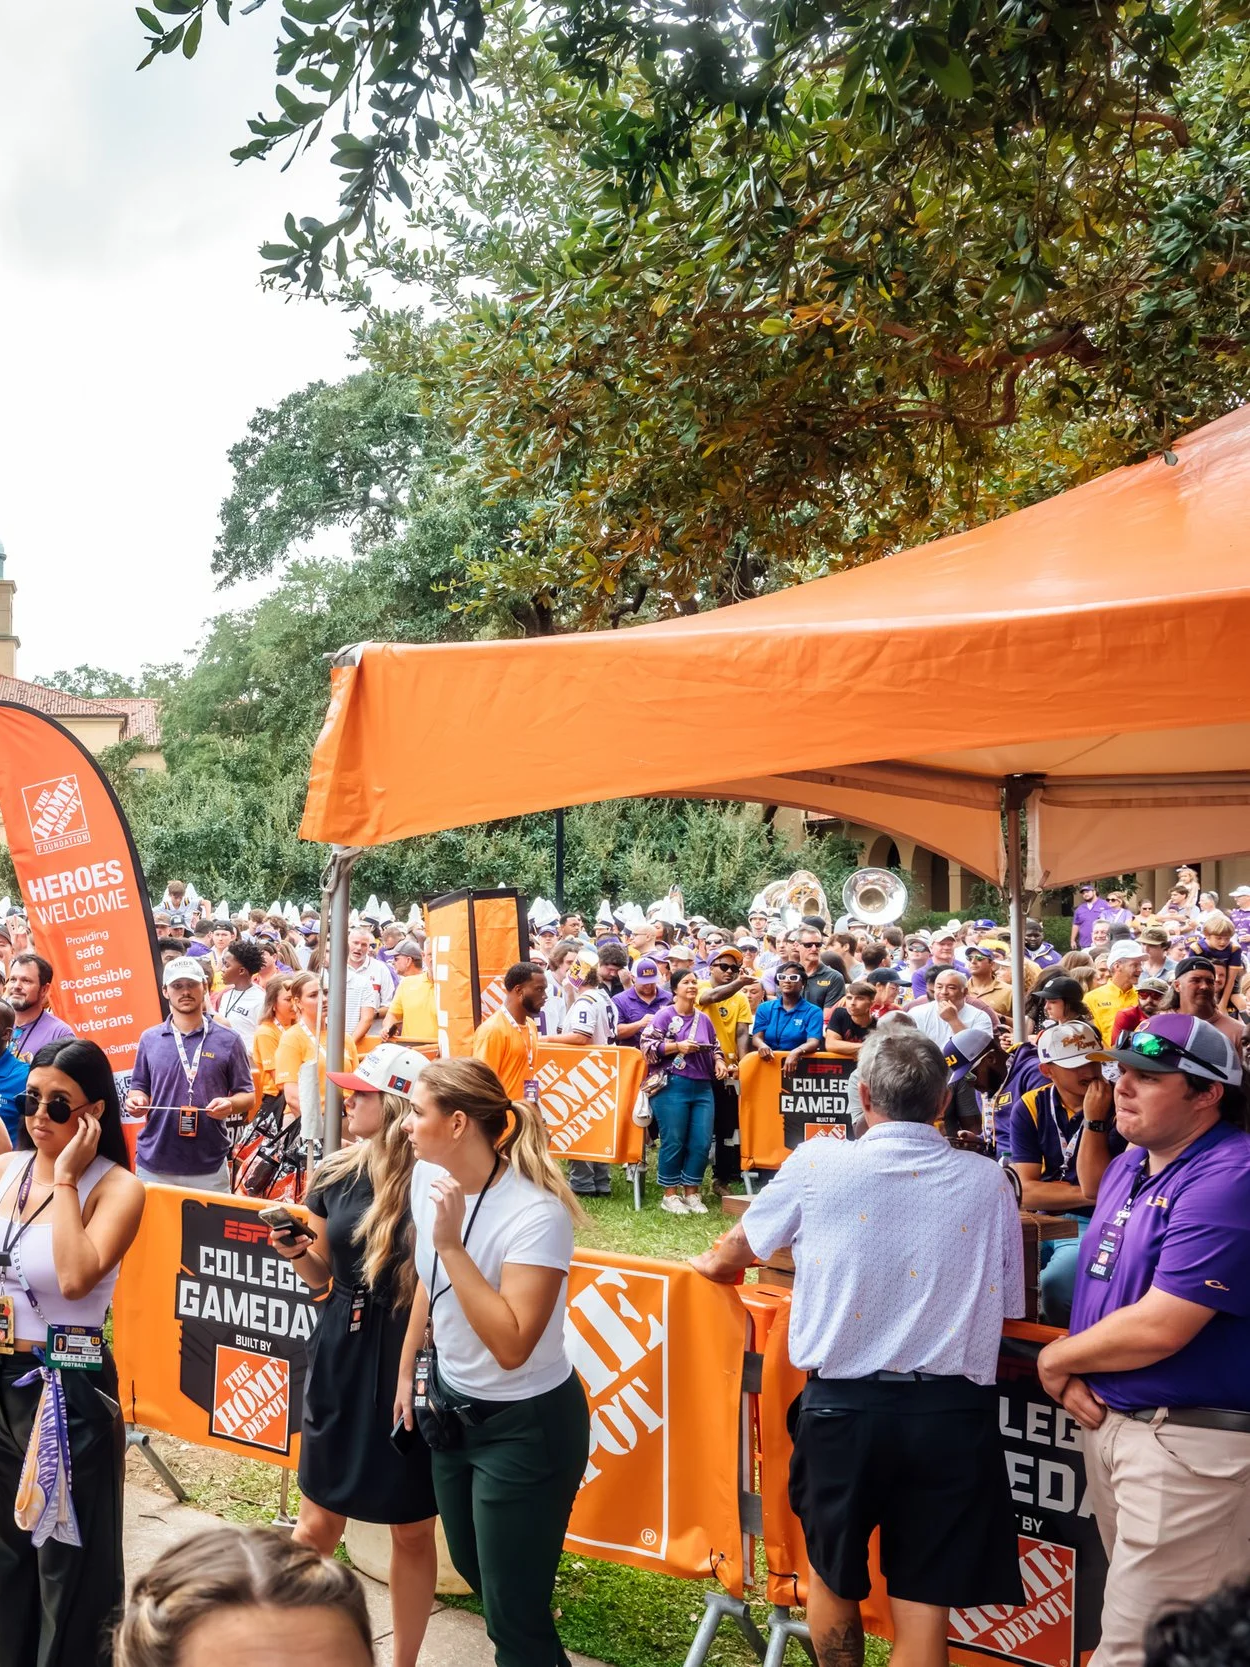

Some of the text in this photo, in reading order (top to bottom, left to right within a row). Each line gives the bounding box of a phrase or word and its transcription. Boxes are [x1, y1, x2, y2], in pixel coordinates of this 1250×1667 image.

[32, 777, 78, 839] HOME
[33, 788, 52, 813] THE
[54, 796, 81, 834] DEPOT
[36, 833, 89, 853] FOUNDATION
[27, 859, 124, 902] HEROES
[35, 888, 129, 926] WELCOME
[66, 930, 109, 946] Providing
[76, 944, 104, 960] safe
[83, 960, 101, 972] and
[60, 968, 132, 990] accessible
[74, 987, 123, 1005] homes
[93, 1005, 108, 1015] for
[232, 1006, 249, 1017] LSU
[579, 1011, 587, 1024] 9
[74, 1014, 133, 1033] veterans
[202, 1051, 215, 1059] LSU
[533, 1059, 564, 1091] HE
[808, 1063, 844, 1075] ESPN
[538, 1050, 618, 1127] OME
[793, 1078, 848, 1093] COLLEG
[781, 1095, 851, 1114] GAMED
[551, 1089, 616, 1152] DEPOT
[235, 1334, 272, 1352] BUILT BY
[61, 1361, 87, 1369] FOOTBALL
[223, 1360, 255, 1393] THE
[214, 1358, 289, 1435] HOME
[241, 1392, 288, 1441] DEPOT
[1022, 1515, 1043, 1533] BY
[991, 1591, 1073, 1653] DEPOT
